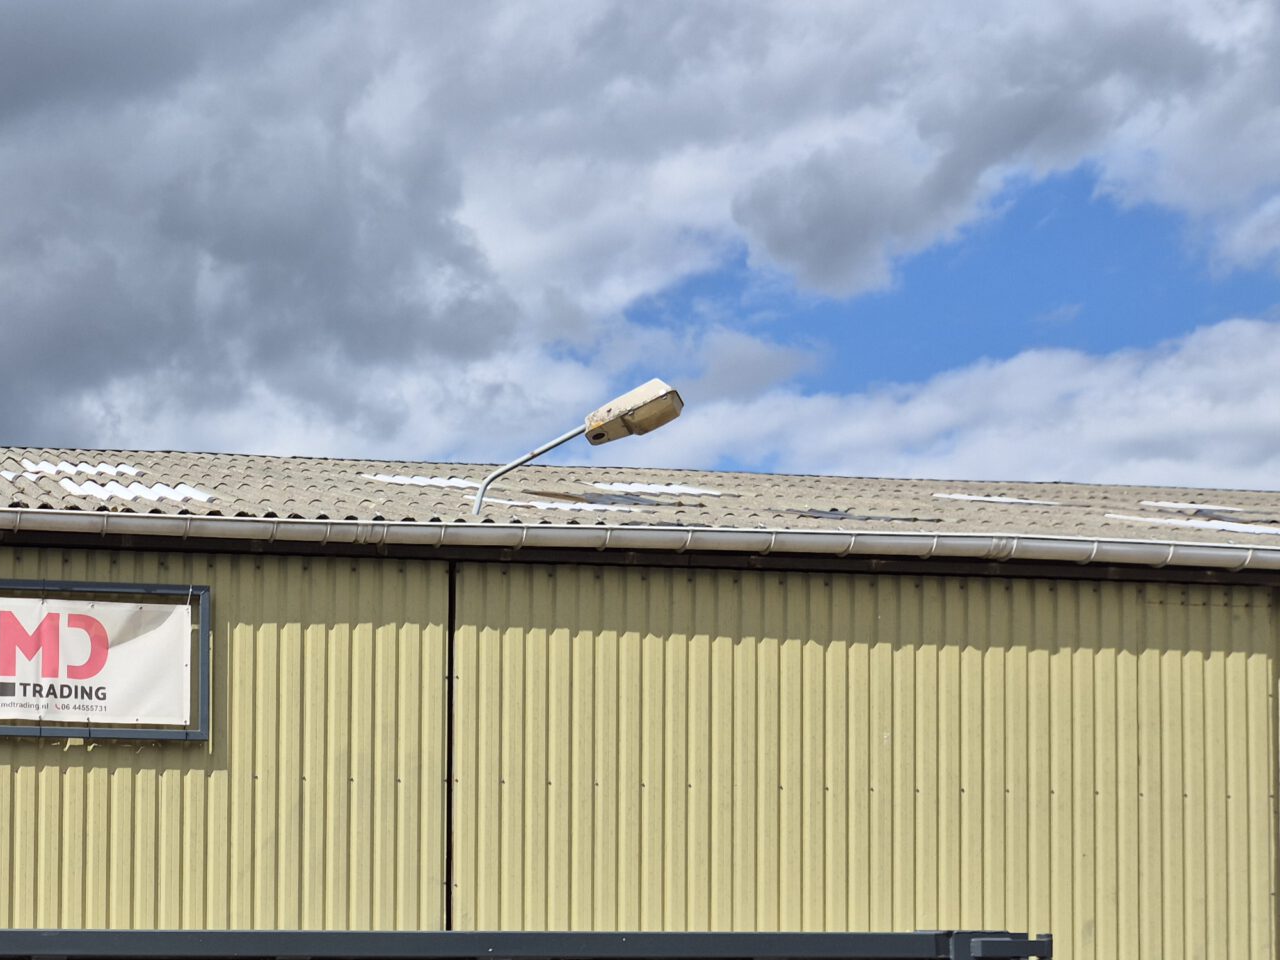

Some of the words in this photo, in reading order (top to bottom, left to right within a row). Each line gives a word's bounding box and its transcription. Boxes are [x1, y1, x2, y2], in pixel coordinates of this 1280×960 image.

[19, 682, 107, 701] TRADING
[61, 703, 70, 711] 06
[72, 703, 107, 712] 44555731
